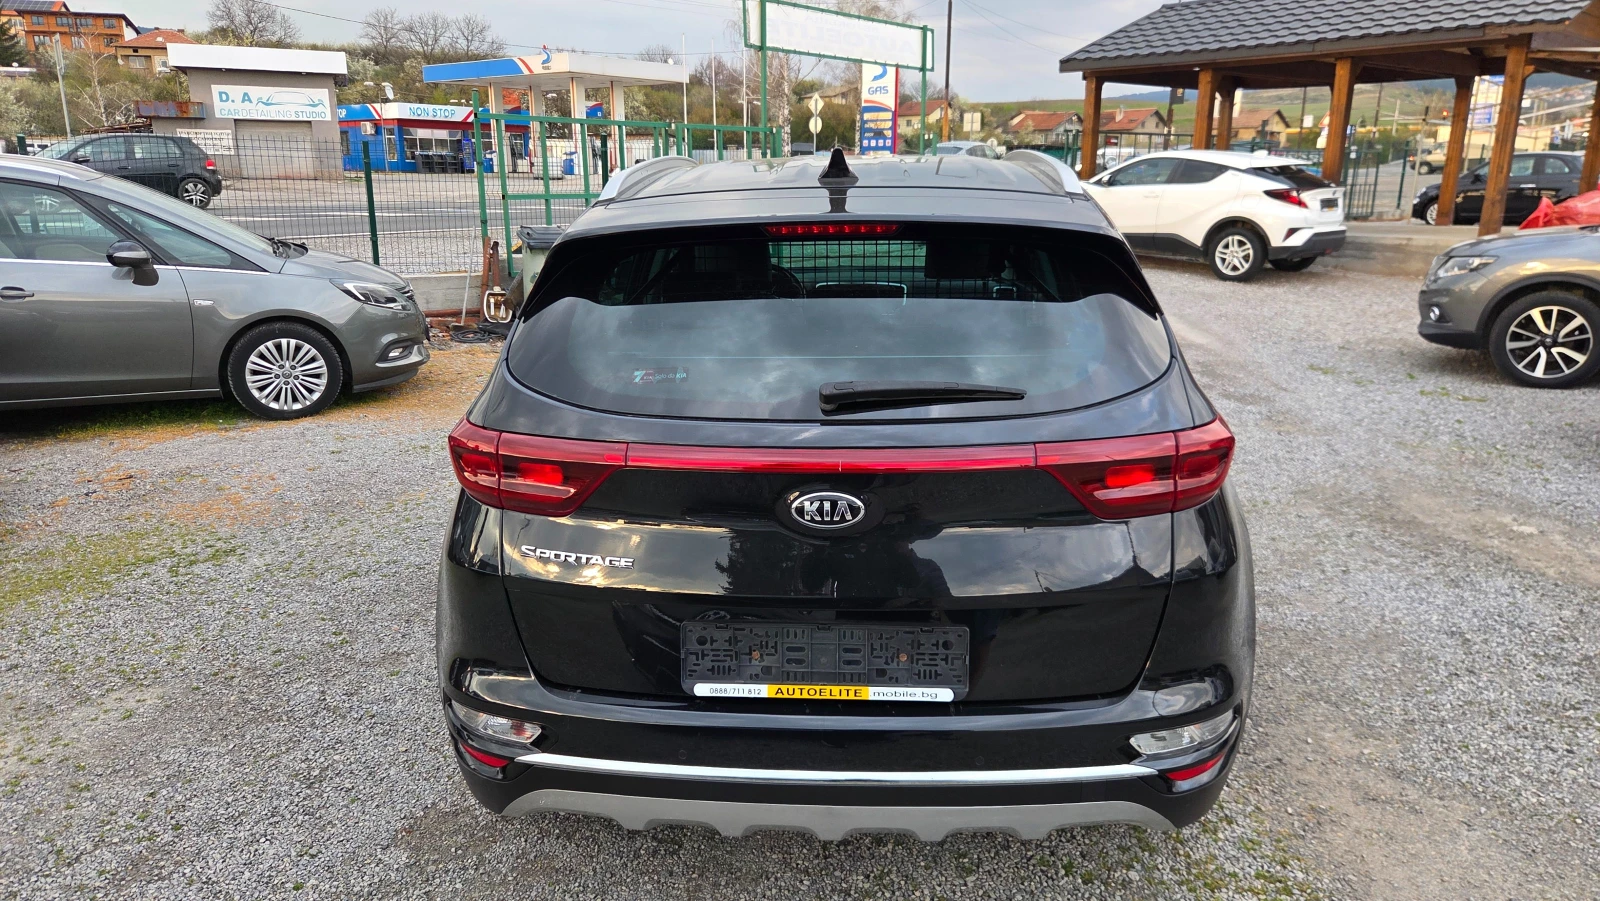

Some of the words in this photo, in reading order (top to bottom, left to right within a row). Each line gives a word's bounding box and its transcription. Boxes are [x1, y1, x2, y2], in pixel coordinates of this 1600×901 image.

[867, 85, 889, 96] GAS
[240, 92, 253, 103] A
[294, 110, 327, 119] STUDIO
[408, 107, 429, 117] NON
[432, 107, 456, 118] STOP
[804, 500, 853, 521] KIA
[520, 545, 634, 570] SPORTAGE
[774, 687, 863, 698] AUTOELITE
